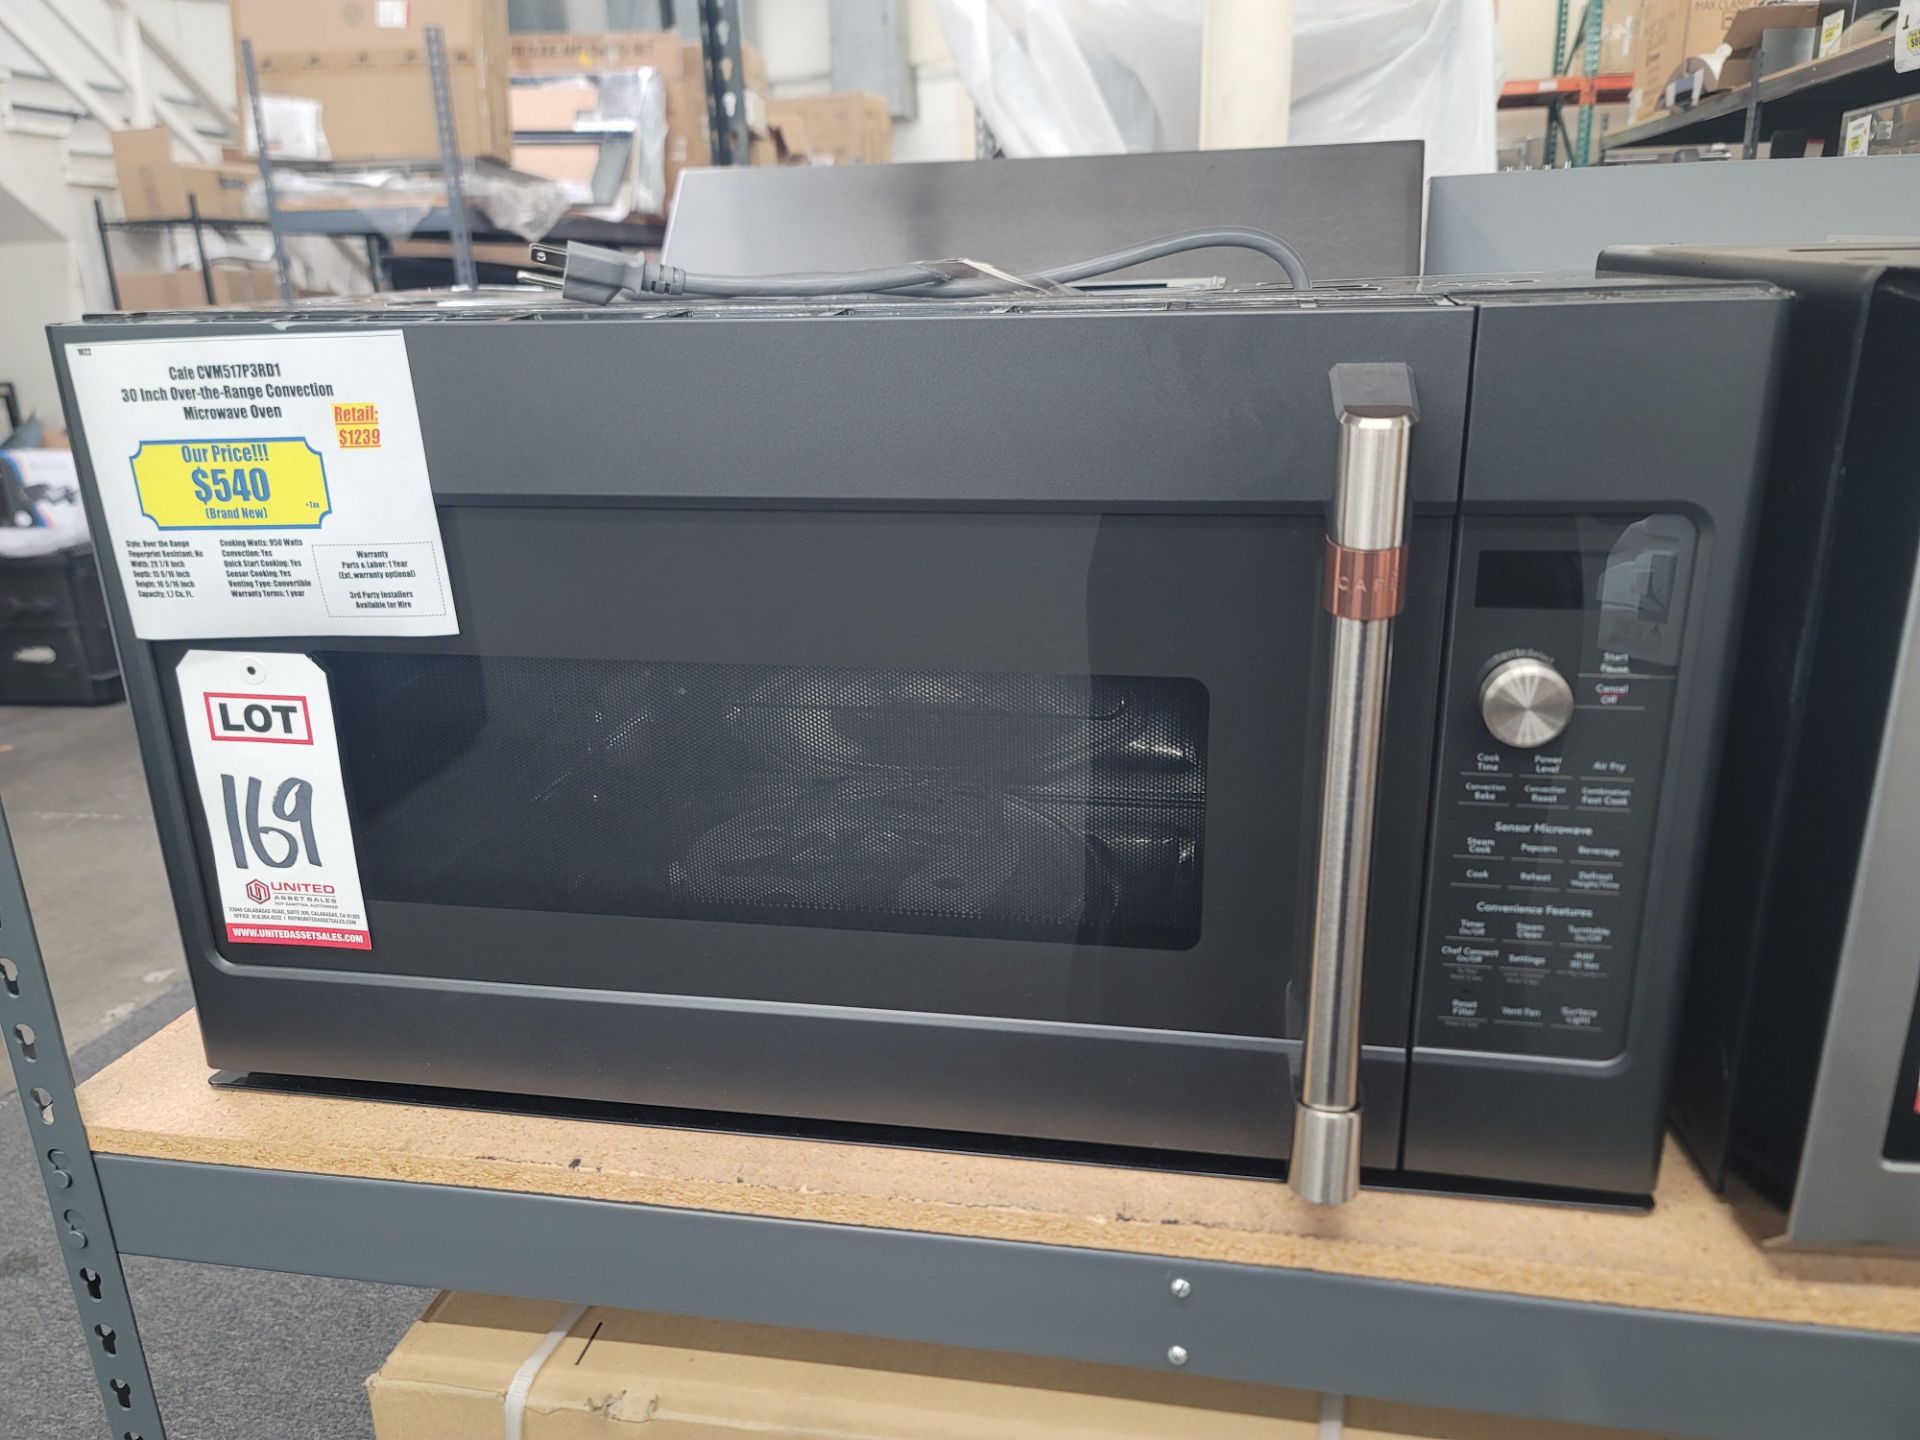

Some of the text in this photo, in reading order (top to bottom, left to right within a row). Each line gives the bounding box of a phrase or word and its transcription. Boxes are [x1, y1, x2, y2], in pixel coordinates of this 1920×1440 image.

[169, 363, 282, 380] Cafe CVM517P3RD1
[121, 382, 334, 402] 30 Inch Over-the-Range Convection
[183, 405, 282, 420] Microwave Oven
[334, 406, 379, 422] Retail:
[339, 428, 381, 447] $1239
[181, 444, 269, 463] Our Price!!!
[191, 466, 271, 505] $540
[205, 507, 268, 520] (Brand New)
[220, 539, 246, 547] Cooking
[283, 538, 303, 546] Watts
[261, 549, 272, 557] Yes
[356, 551, 388, 559] Warranty
[224, 560, 242, 568] Quick
[290, 559, 302, 567] Yes
[341, 561, 359, 569] Parts
[226, 570, 249, 578] Sensor
[279, 569, 291, 577] Yes
[353, 571, 384, 580] warranty
[228, 580, 254, 588] Venting
[273, 579, 312, 587] Convertible
[231, 590, 262, 598] Warranty
[349, 591, 414, 600] 3rd Party Installers
[1603, 652, 1628, 663] Start
[1595, 683, 1629, 694] Cancel
[1601, 696, 1618, 704] Off
[219, 703, 298, 734] LOT
[1477, 753, 1500, 762] Cook
[1534, 754, 1562, 765] Power
[1477, 762, 1499, 772] Time
[1535, 764, 1560, 773] Level
[1593, 761, 1627, 774] Air Fry
[1474, 791, 1496, 800] Bake
[221, 773, 322, 869] 169
[1495, 821, 1593, 836] Sensor Microwave
[1467, 836, 1495, 846] Steam
[1468, 845, 1492, 854] Cook
[1521, 843, 1558, 854] Popcorn
[1466, 869, 1488, 879] Cook
[270, 881, 335, 895] UNITED
[1476, 901, 1593, 918] Convenience Features
[1460, 919, 1485, 928] Timer
[232, 927, 364, 943] WWW.UNITEDASSETSALES.COM
